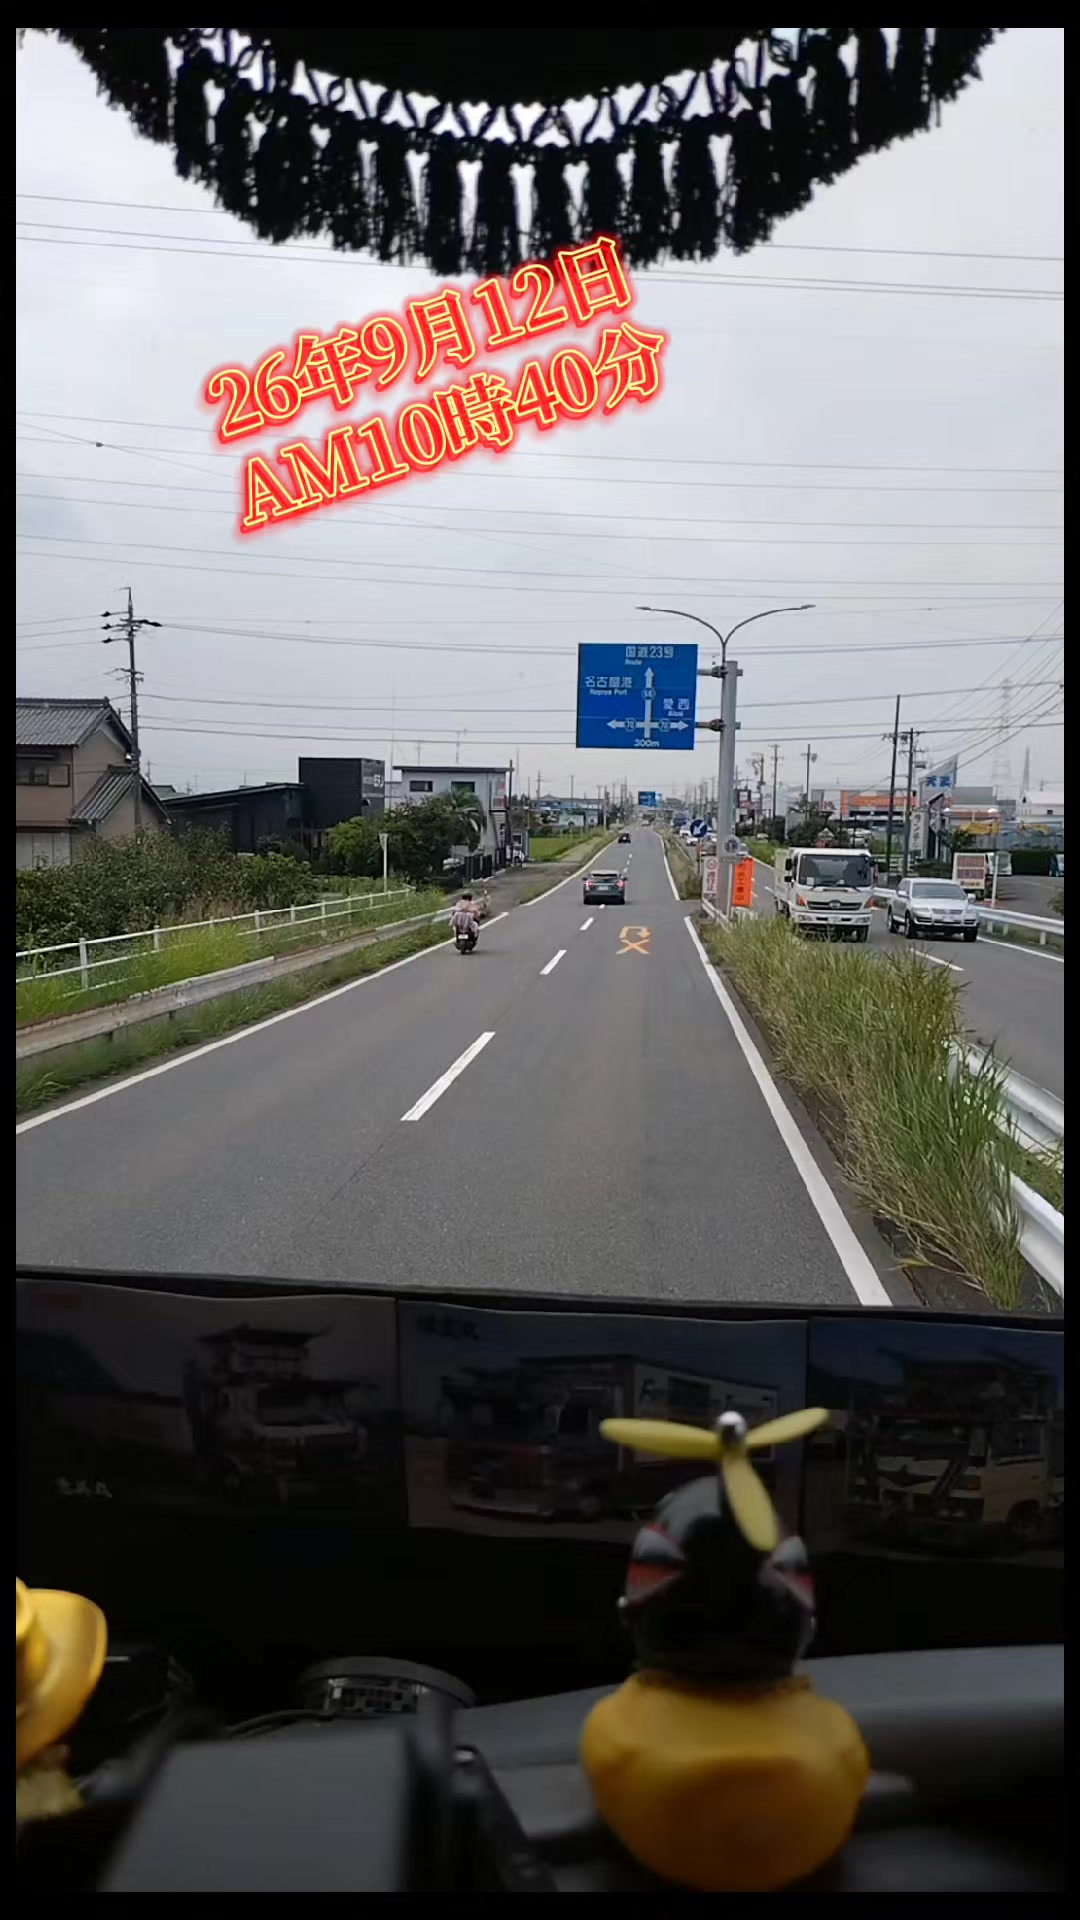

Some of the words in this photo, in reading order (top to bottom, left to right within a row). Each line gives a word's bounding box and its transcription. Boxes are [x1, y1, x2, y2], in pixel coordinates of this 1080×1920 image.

[625, 645, 674, 658] 国道23号
[585, 675, 633, 688] 名古屋港
[663, 698, 690, 711] 愛西
[633, 738, 660, 747] 300m
